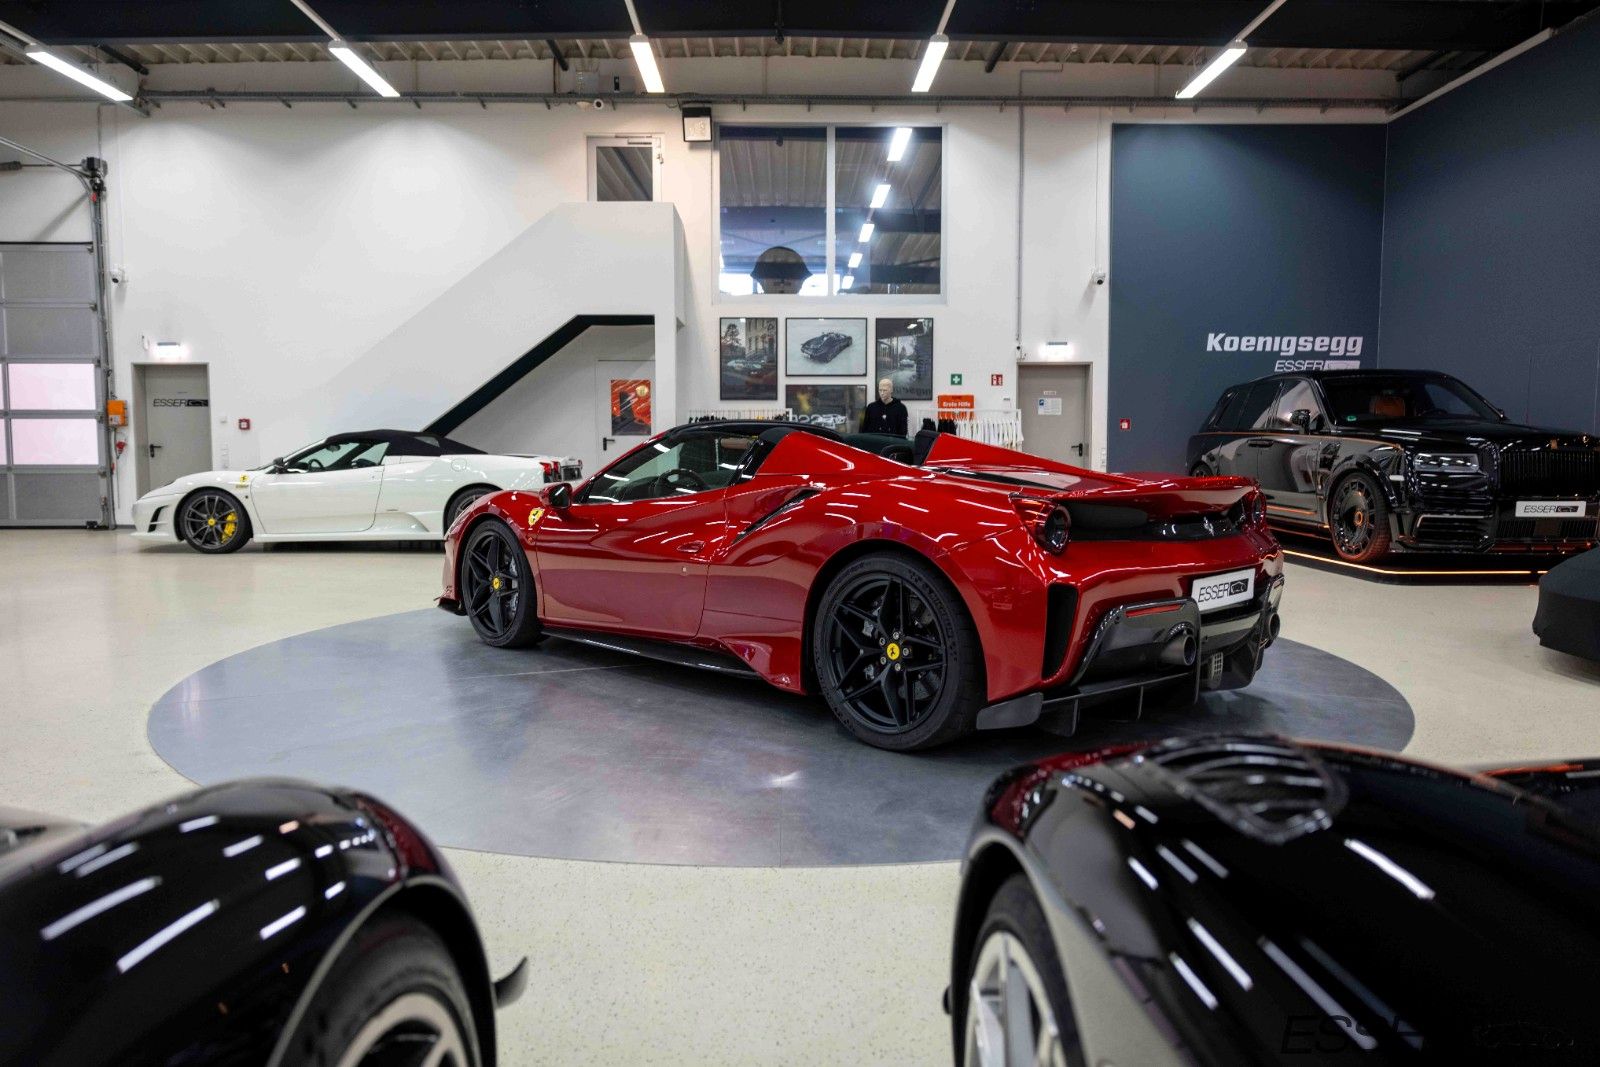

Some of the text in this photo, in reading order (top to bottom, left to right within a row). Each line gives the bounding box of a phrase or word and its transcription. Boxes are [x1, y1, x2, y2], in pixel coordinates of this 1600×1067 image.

[1206, 332, 1363, 356] Koenigsegg
[153, 399, 187, 407] ESSER
[1523, 505, 1556, 513] ESSER
[1198, 582, 1230, 603] ESSER
